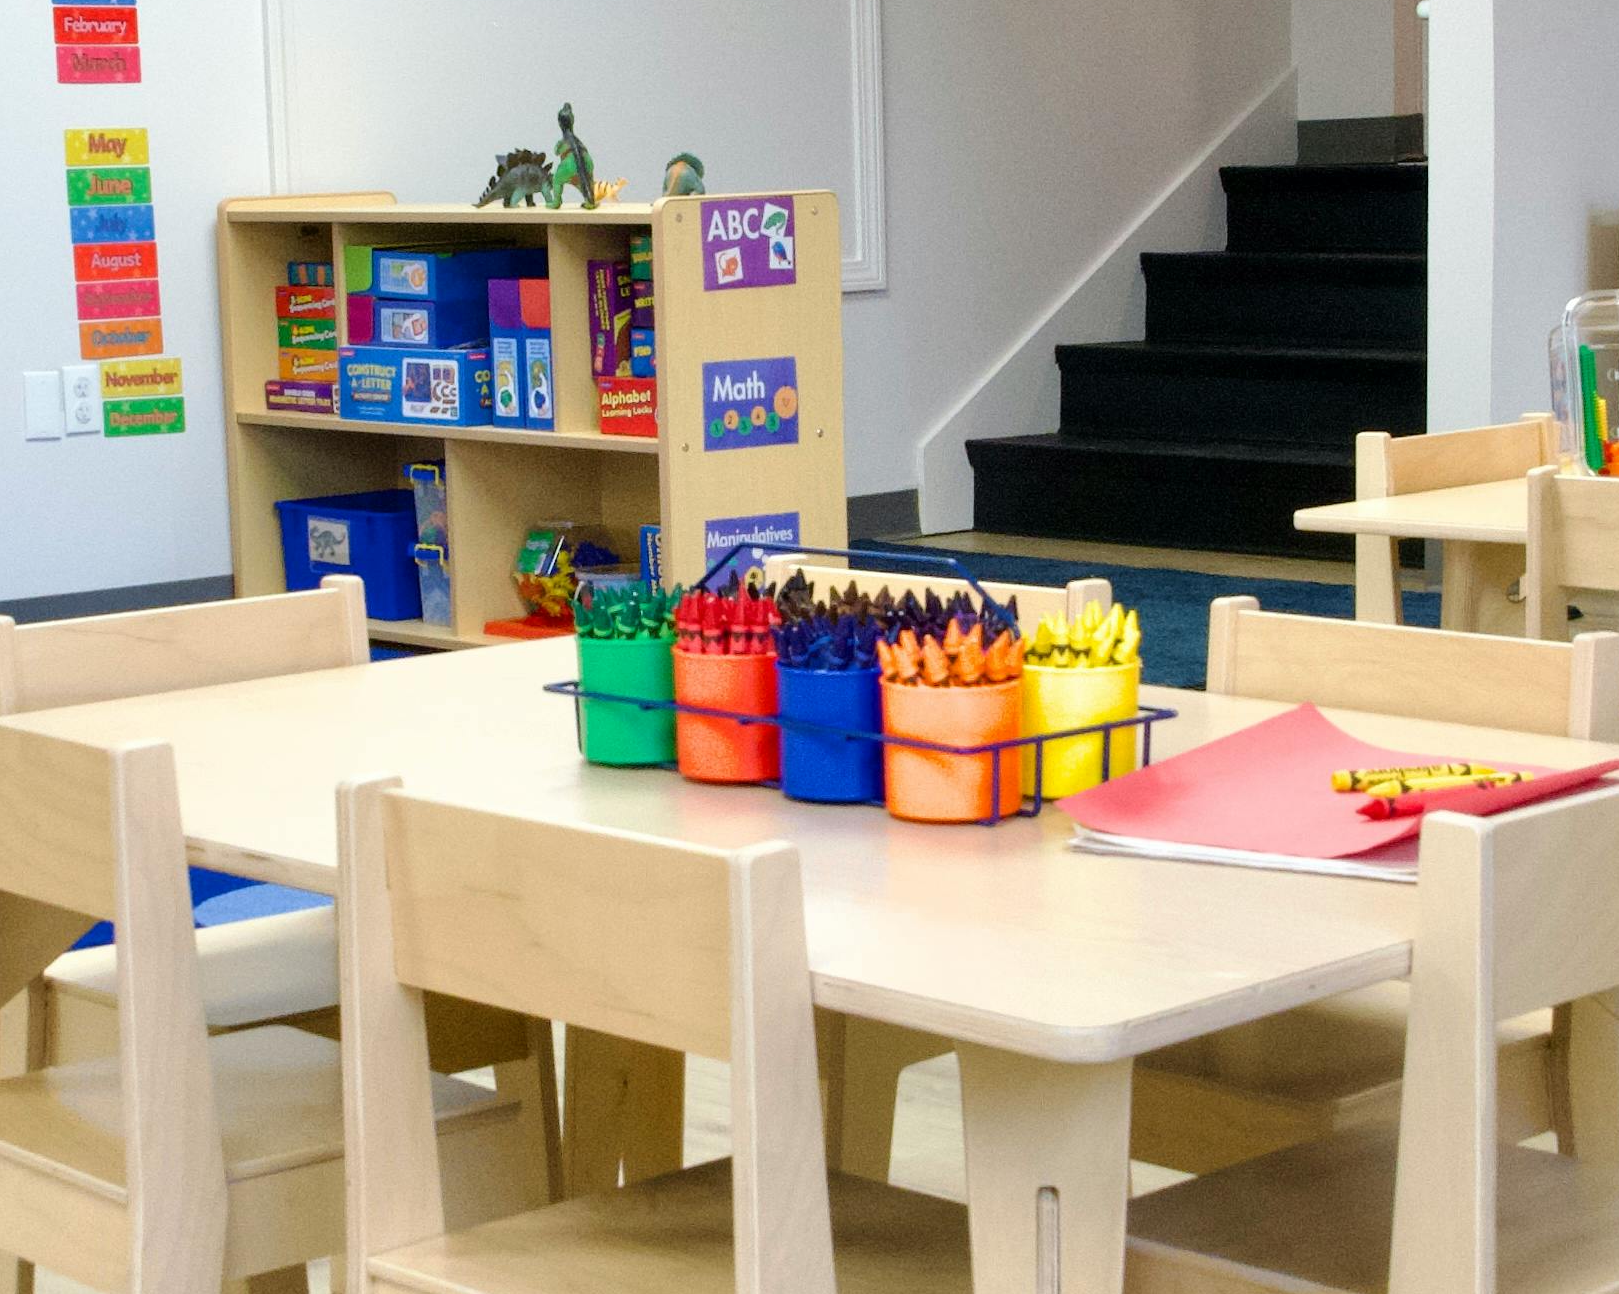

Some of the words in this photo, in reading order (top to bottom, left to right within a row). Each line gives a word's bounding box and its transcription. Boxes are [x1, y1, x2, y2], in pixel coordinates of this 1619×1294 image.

[63, 15, 127, 36] February
[87, 133, 128, 158] May
[86, 174, 132, 196] June
[707, 207, 760, 242] ABC
[91, 251, 142, 272] August
[105, 368, 178, 388] November
[712, 370, 766, 402] Math
[601, 389, 651, 409] Alphabet
[109, 407, 178, 427] December
